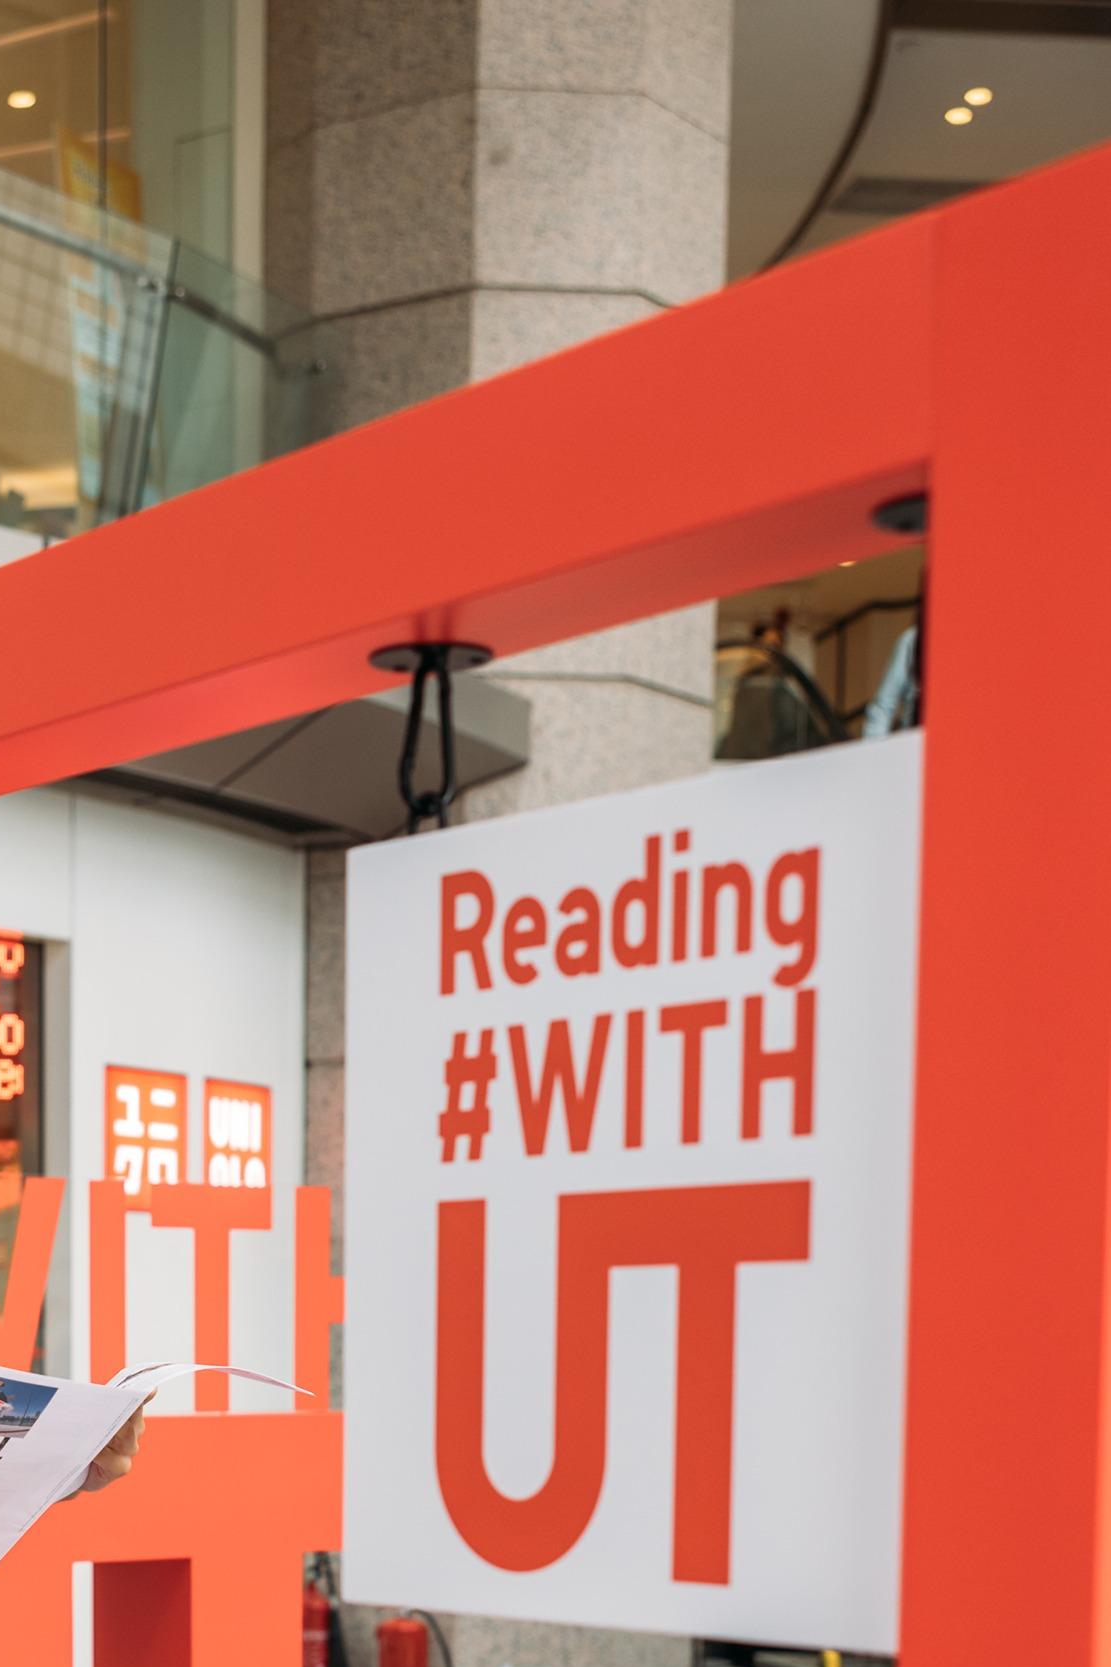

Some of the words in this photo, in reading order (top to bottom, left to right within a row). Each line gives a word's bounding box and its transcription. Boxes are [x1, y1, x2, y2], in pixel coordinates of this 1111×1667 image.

[439, 828, 822, 996] Reading
[113, 1083, 178, 1141] ユニ
[209, 1095, 263, 1153] UNI
[438, 988, 817, 1164] #WITH
[435, 1179, 813, 1587] UT
